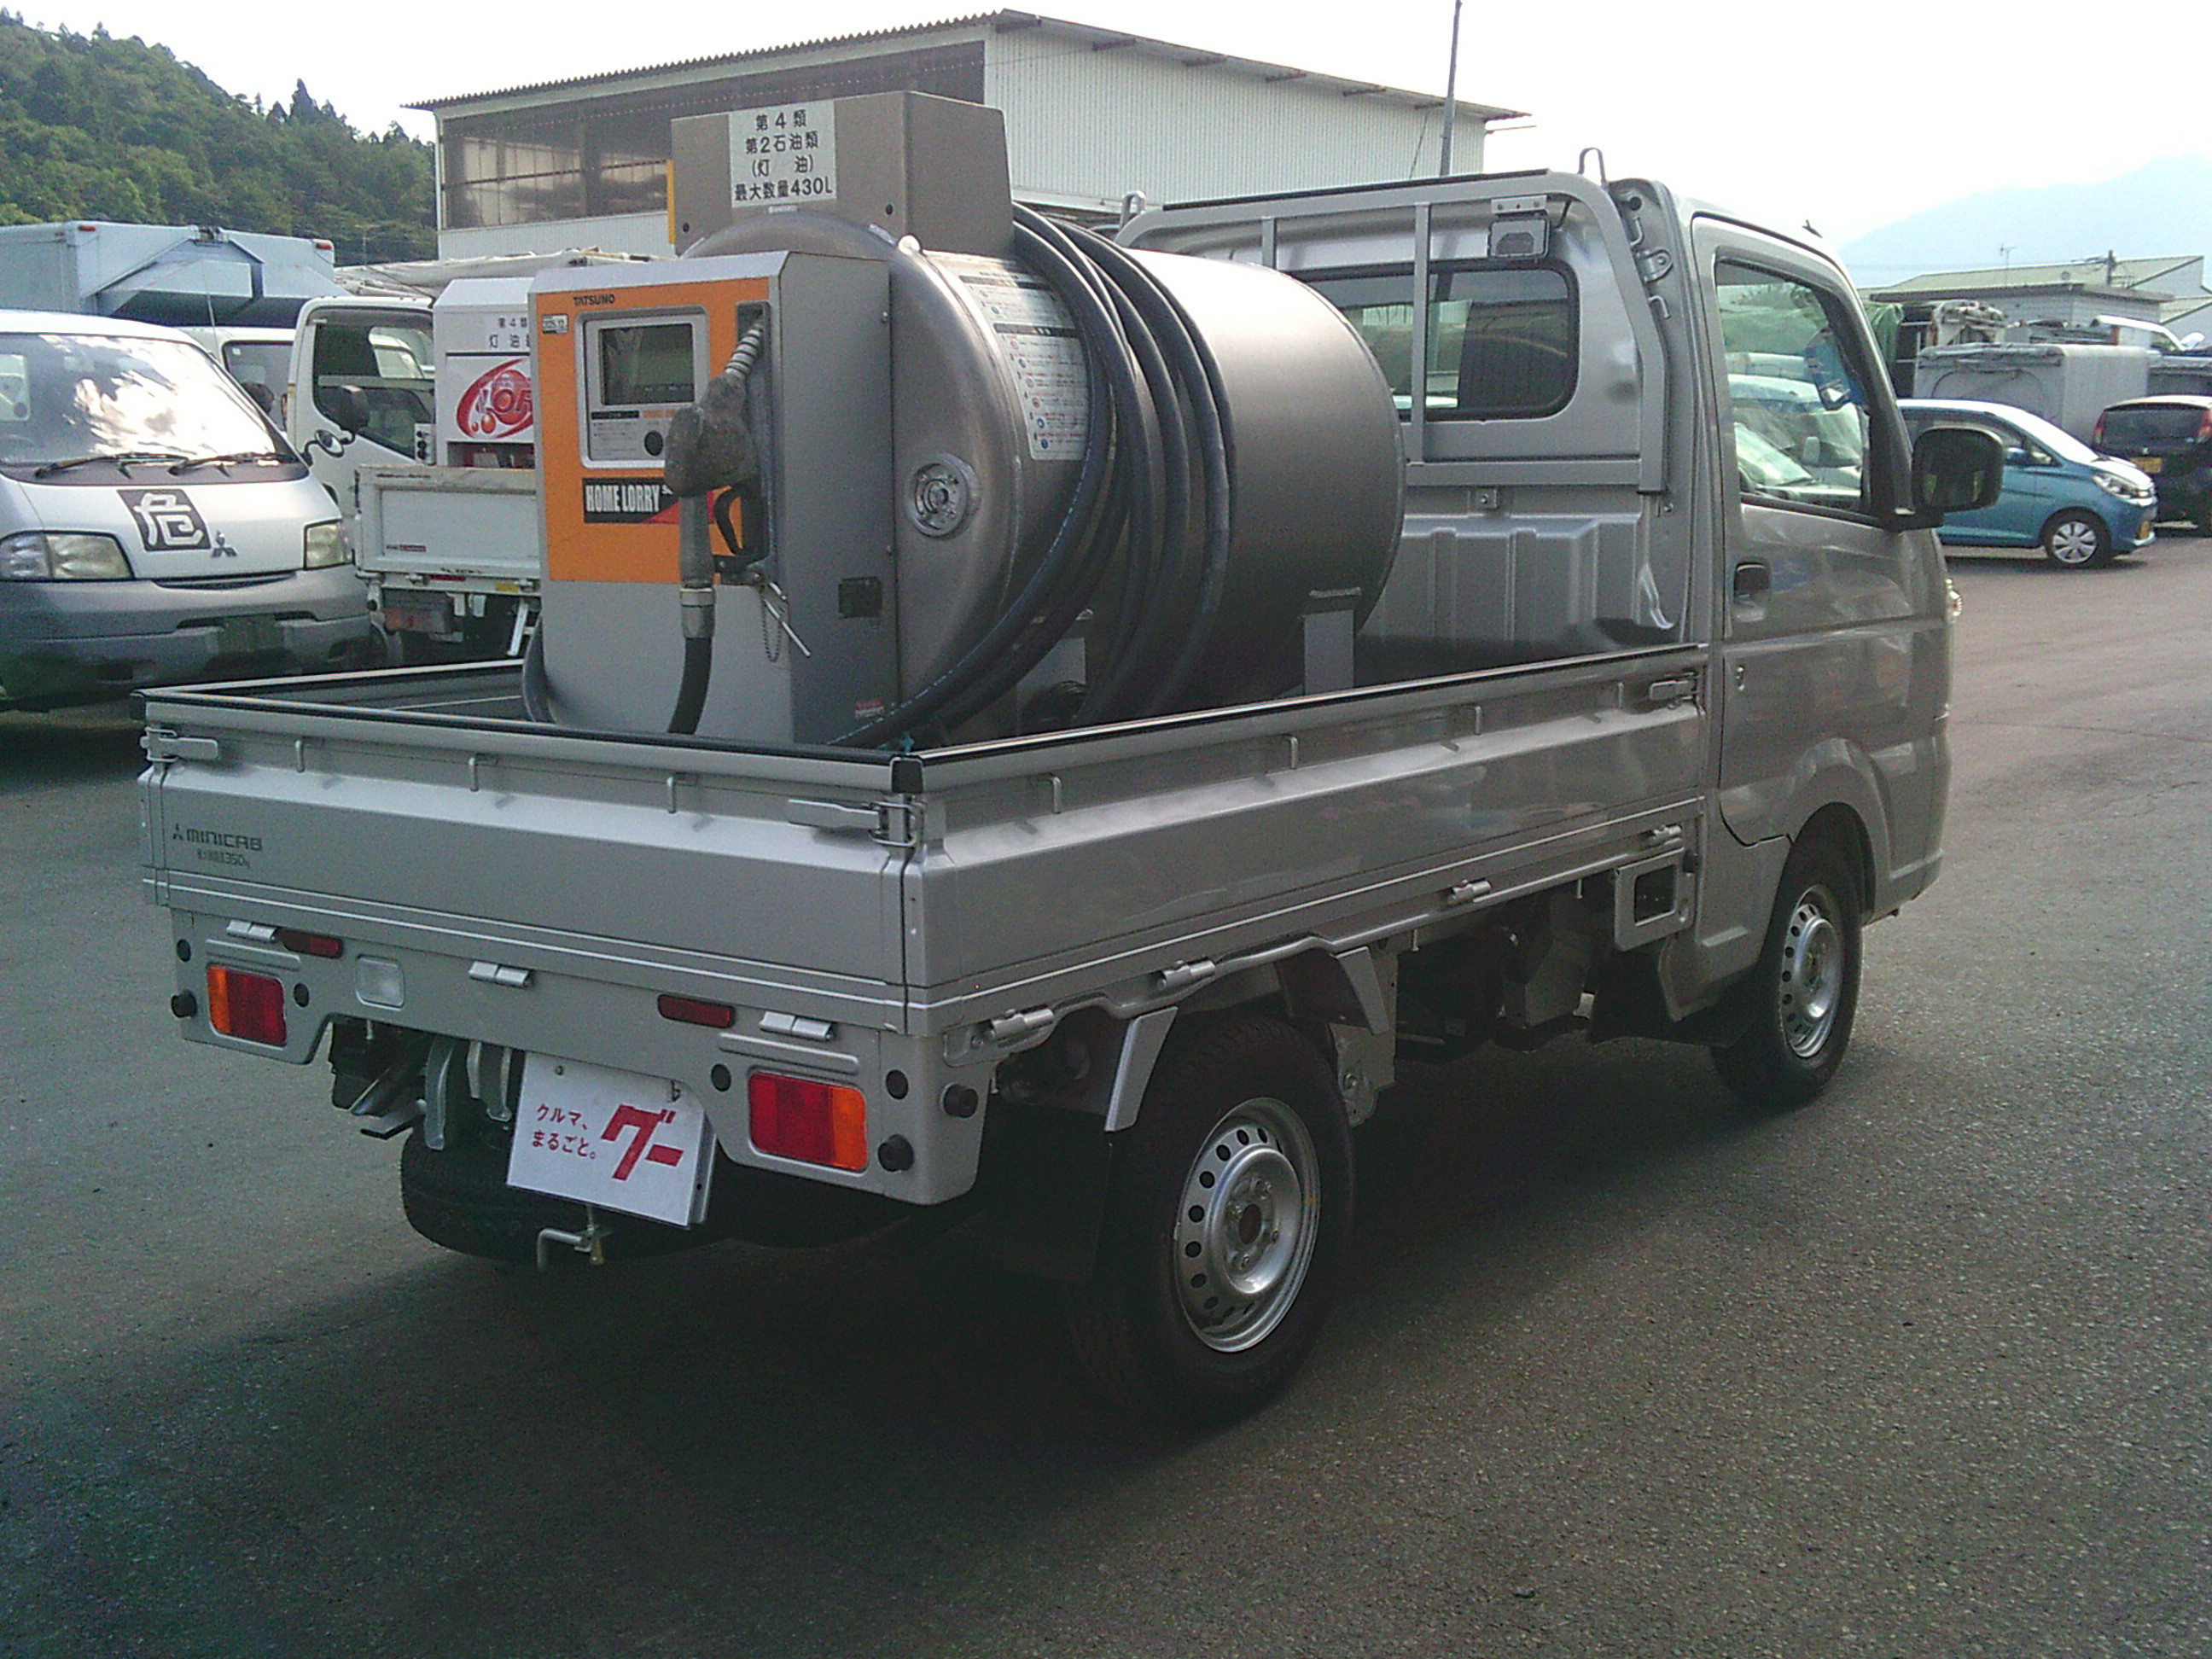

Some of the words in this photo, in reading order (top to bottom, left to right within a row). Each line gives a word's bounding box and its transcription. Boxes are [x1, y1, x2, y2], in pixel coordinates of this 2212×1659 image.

[755, 108, 806, 131] 第4類
[745, 131, 818, 154] 第2石油類
[573, 294, 615, 306] TATSUNO
[585, 484, 621, 512] HOME
[621, 484, 661, 512] LORRY
[132, 492, 204, 546] 危
[186, 829, 263, 851] MINICAB
[532, 1129, 596, 1160] まるごと。
[601, 1104, 684, 1181] グー
